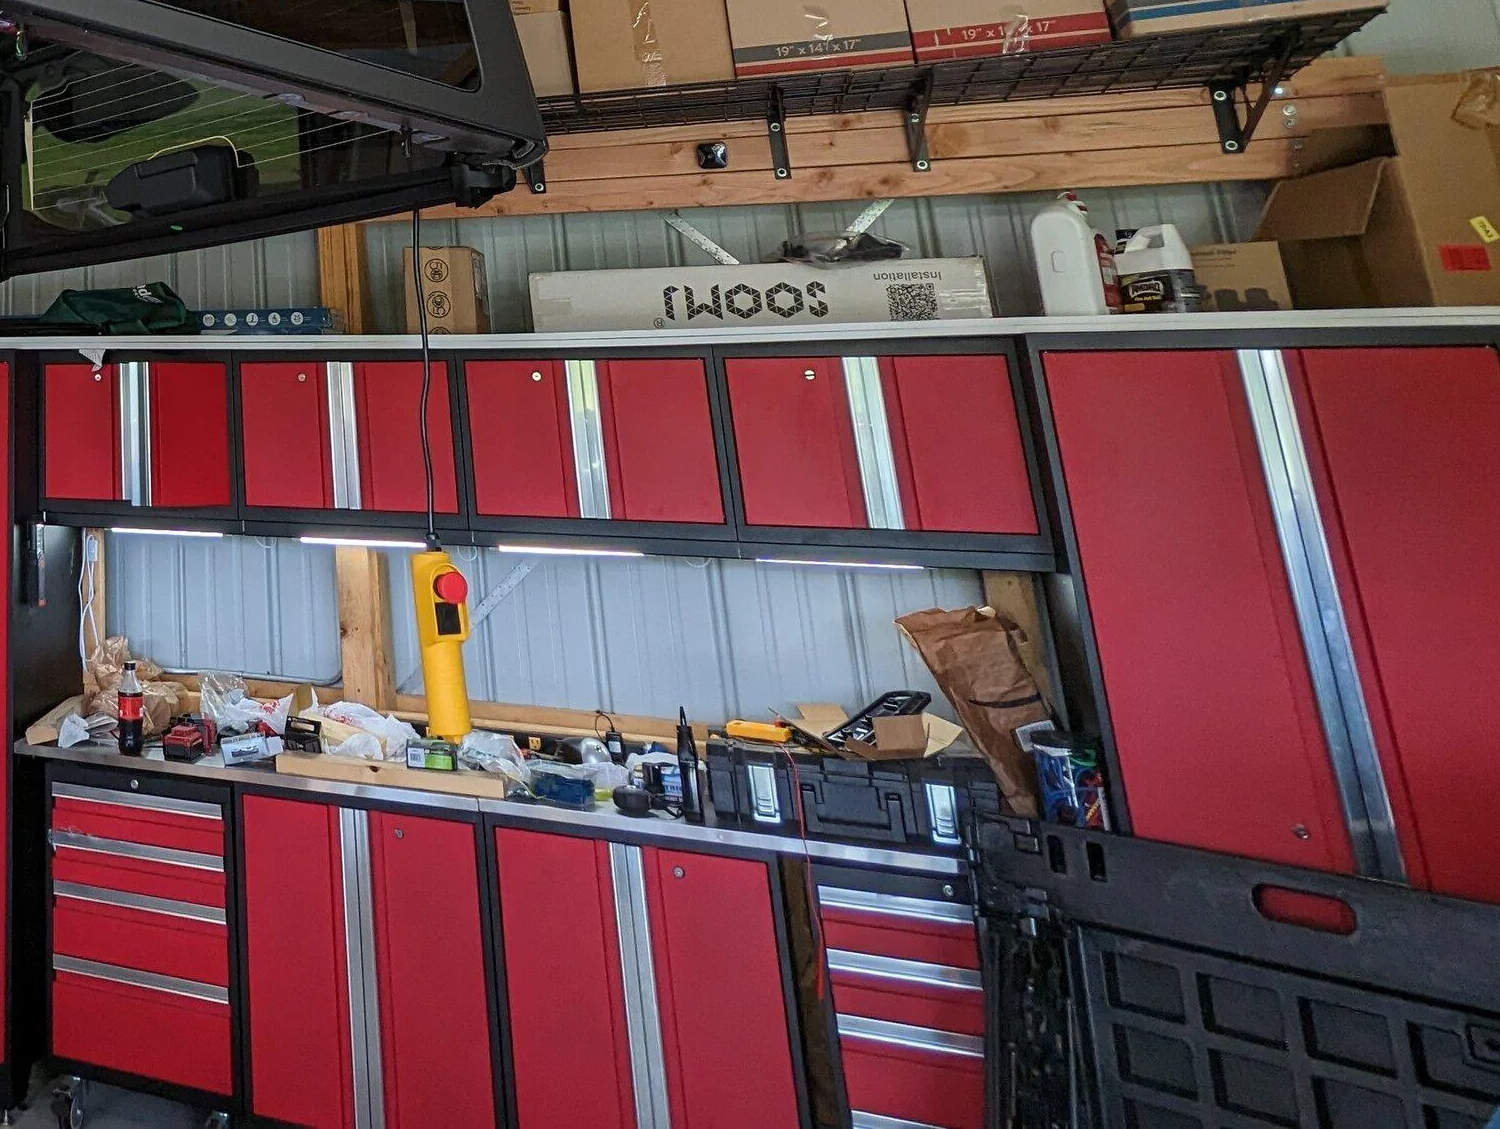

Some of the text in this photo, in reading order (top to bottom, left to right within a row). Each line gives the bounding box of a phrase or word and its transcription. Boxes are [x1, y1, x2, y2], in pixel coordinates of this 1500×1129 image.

[962, 27, 983, 41] 19"
[986, 29, 995, 38] x
[776, 45, 795, 57] 19"
[799, 47, 807, 55] x
[832, 43, 841, 52] x
[842, 37, 861, 51] 17"
[873, 270, 943, 281] Installation
